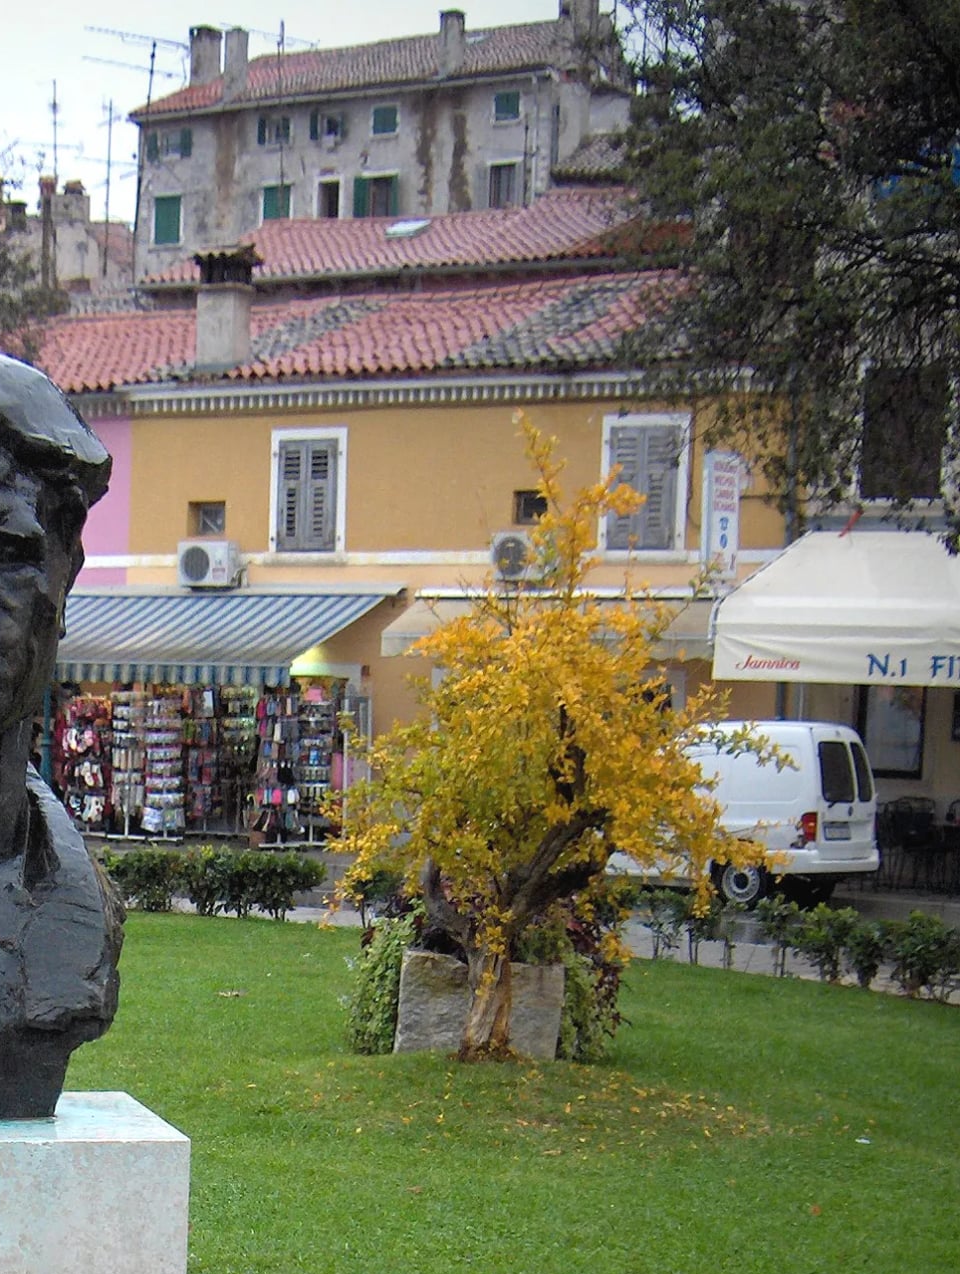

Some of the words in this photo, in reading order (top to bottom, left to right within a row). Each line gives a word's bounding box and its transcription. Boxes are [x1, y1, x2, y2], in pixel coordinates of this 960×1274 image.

[736, 655, 800, 670] Jamnica
[866, 653, 907, 678] N.1
[929, 655, 960, 678] FI
